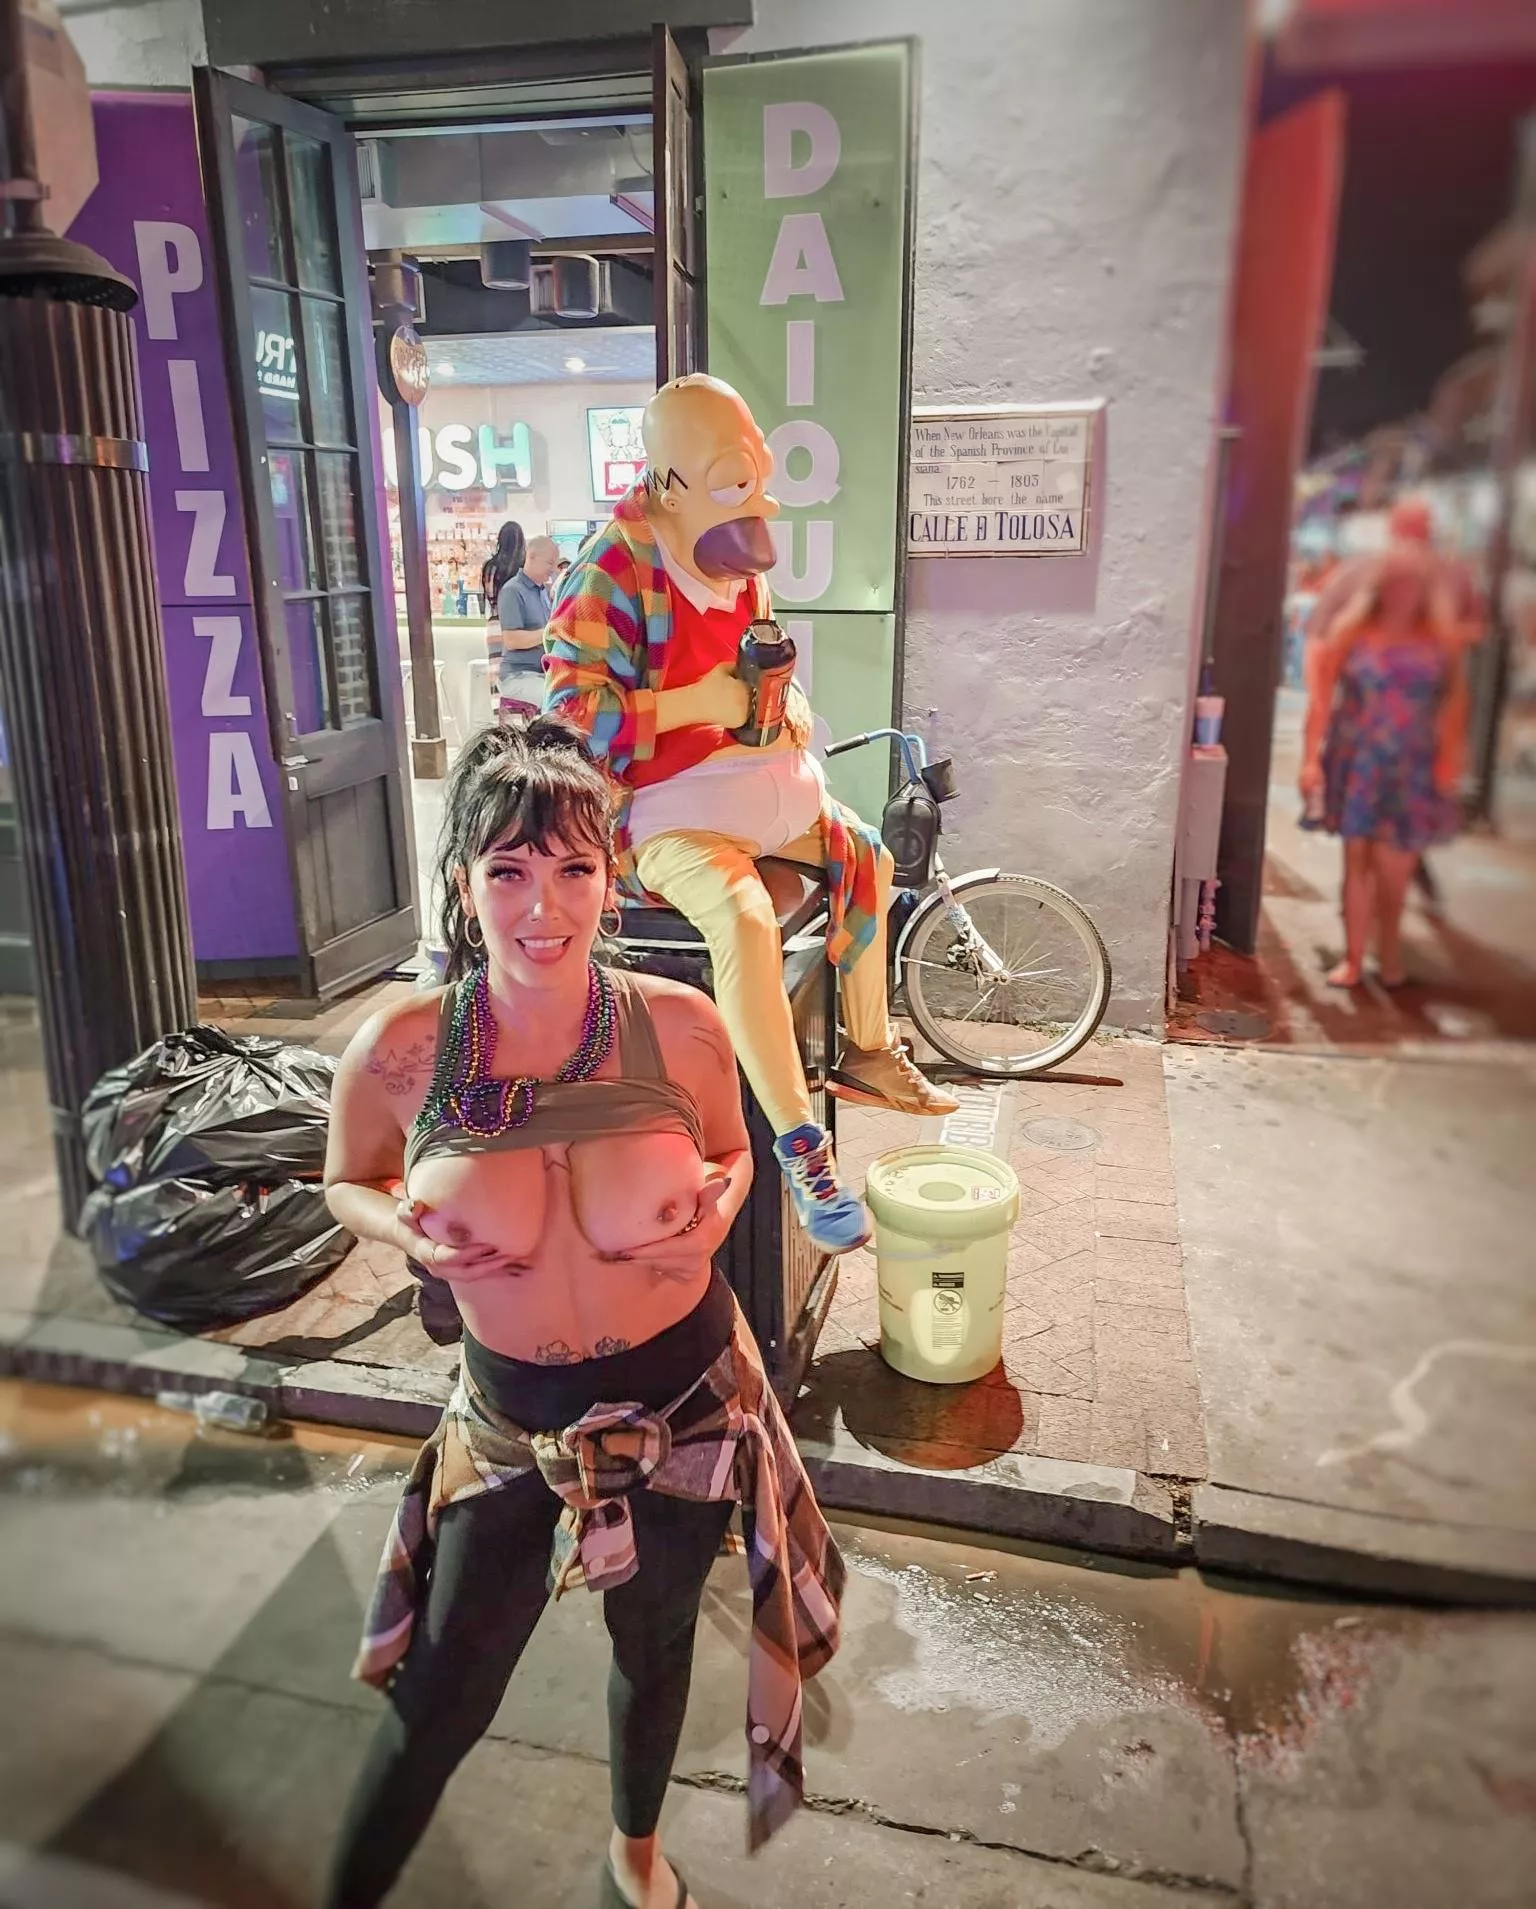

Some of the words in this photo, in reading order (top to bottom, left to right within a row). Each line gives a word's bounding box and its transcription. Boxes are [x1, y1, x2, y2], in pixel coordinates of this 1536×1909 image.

[915, 428, 942, 442] When
[944, 426, 963, 441] New
[968, 426, 1004, 441] Orleans
[1007, 428, 1027, 439] was
[1029, 425, 1043, 438] the
[915, 445, 927, 458] of
[930, 445, 945, 458] the
[950, 444, 986, 461] Spanish
[991, 442, 1034, 457] Province
[1039, 442, 1050, 455] of
[946, 476, 976, 490] 1762
[1010, 474, 1039, 488] 1803
[924, 493, 942, 506] This
[945, 494, 976, 506] street
[982, 492, 1003, 506] bore
[1010, 492, 1027, 505] the
[1036, 493, 1063, 505] name
[133, 220, 273, 830] PIZZA
[910, 513, 968, 543] CALLE
[995, 511, 1075, 541] TOLOSA
